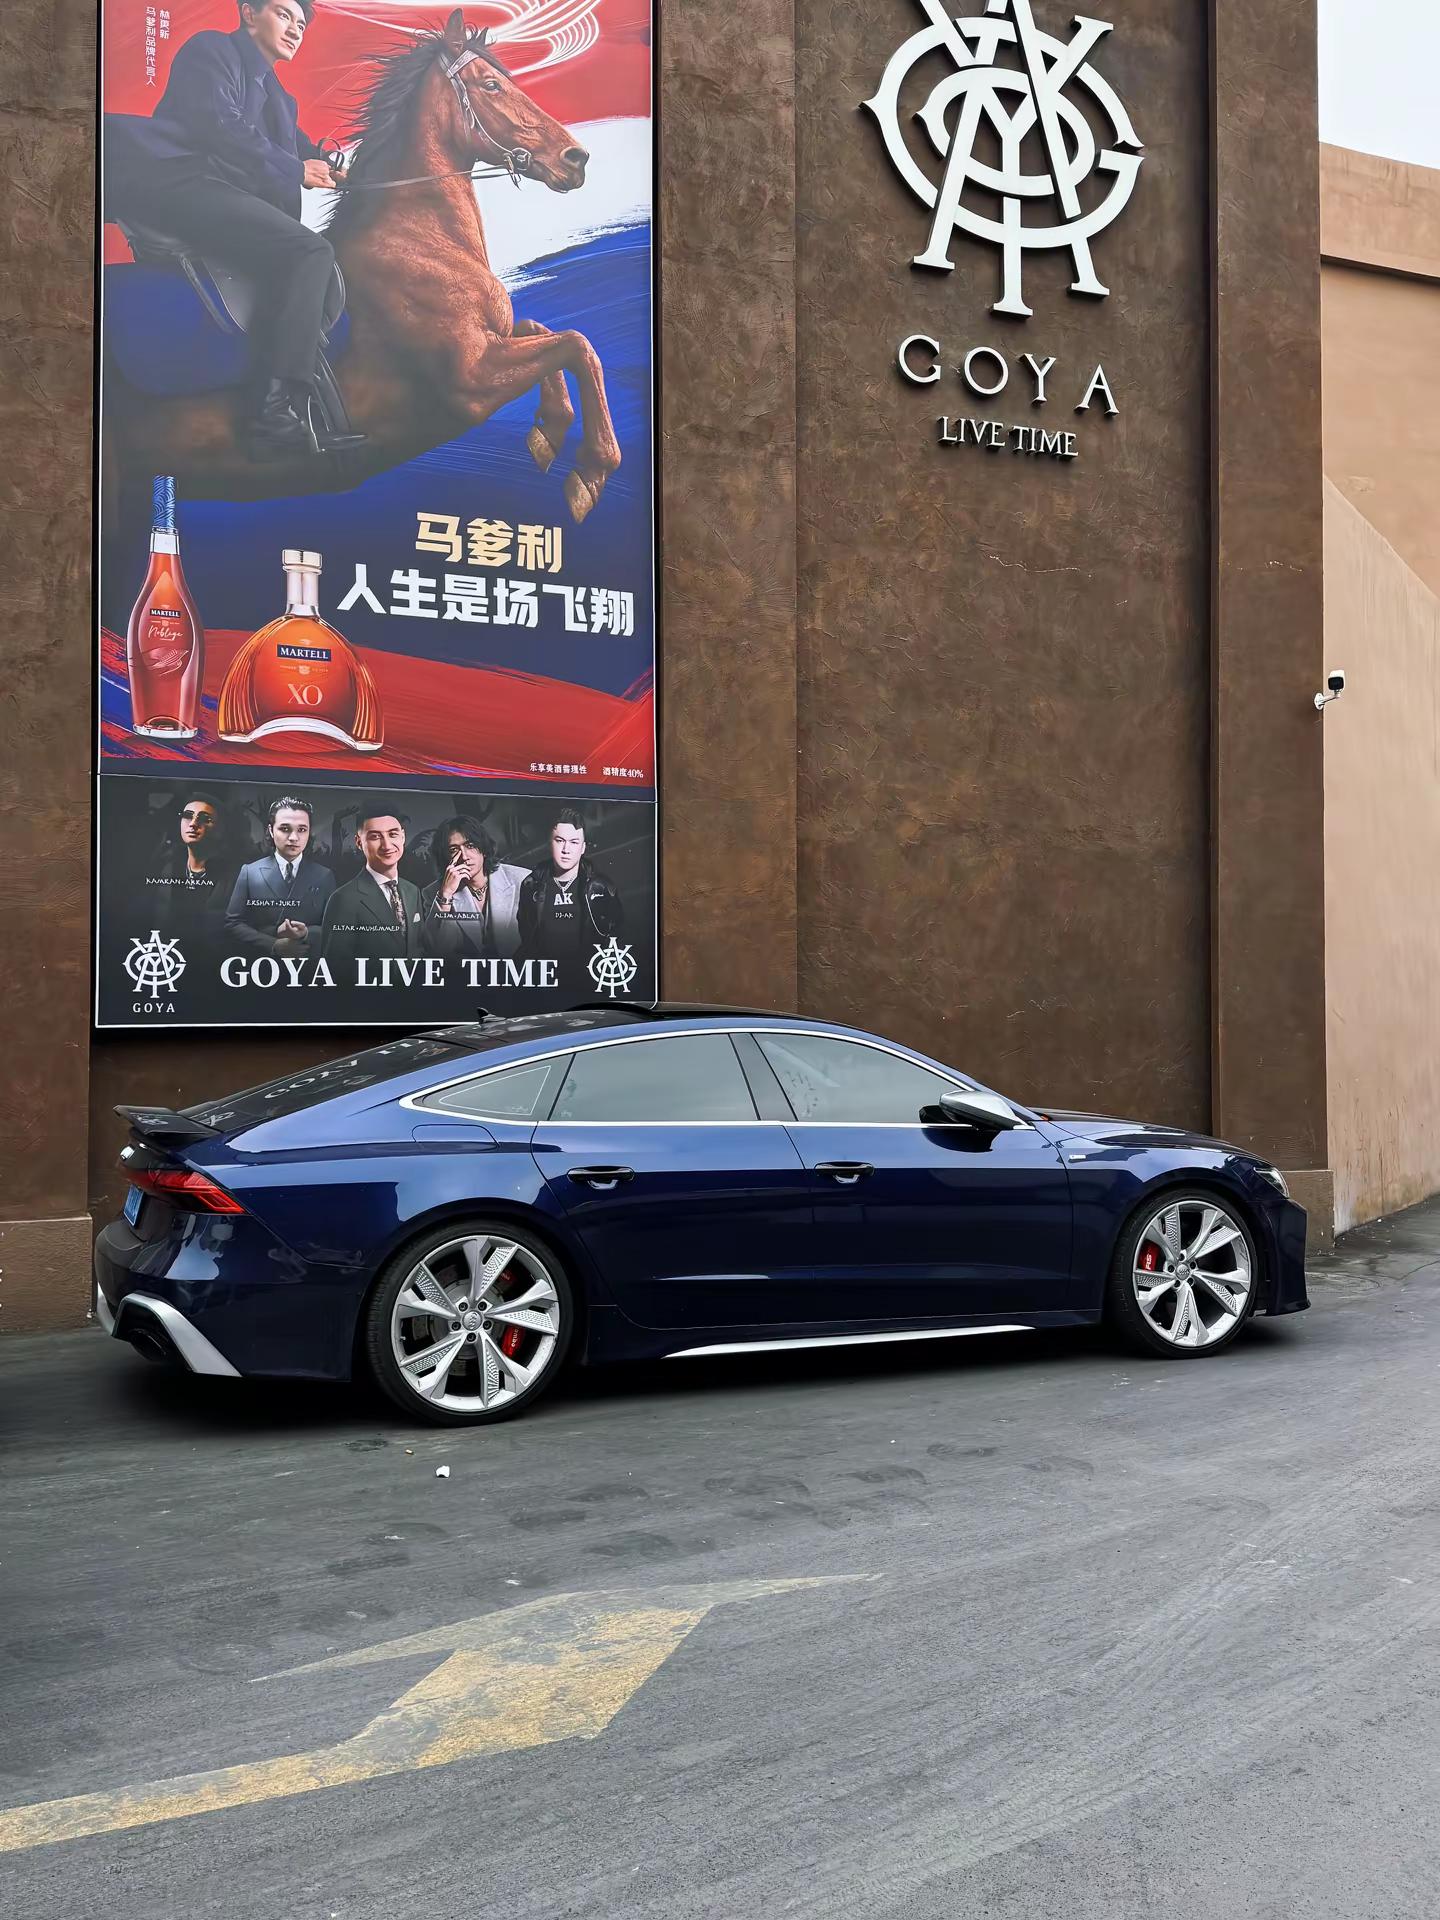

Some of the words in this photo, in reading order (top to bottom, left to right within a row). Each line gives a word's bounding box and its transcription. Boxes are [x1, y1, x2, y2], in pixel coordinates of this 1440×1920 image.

[898, 333, 1120, 415] GOYA
[938, 415, 1006, 448] LIVE
[1007, 424, 1079, 458] TIME
[415, 511, 562, 574] 马爹利
[336, 562, 635, 637] 人生是场飞翔
[151, 609, 181, 618] MARTELL
[280, 646, 329, 660] MARTELL
[287, 683, 323, 706] XO
[553, 892, 574, 906] AK
[219, 956, 337, 988] GOYA
[354, 957, 445, 988] LIVE
[461, 958, 559, 988] TIME
[132, 1002, 176, 1014] GOYA
